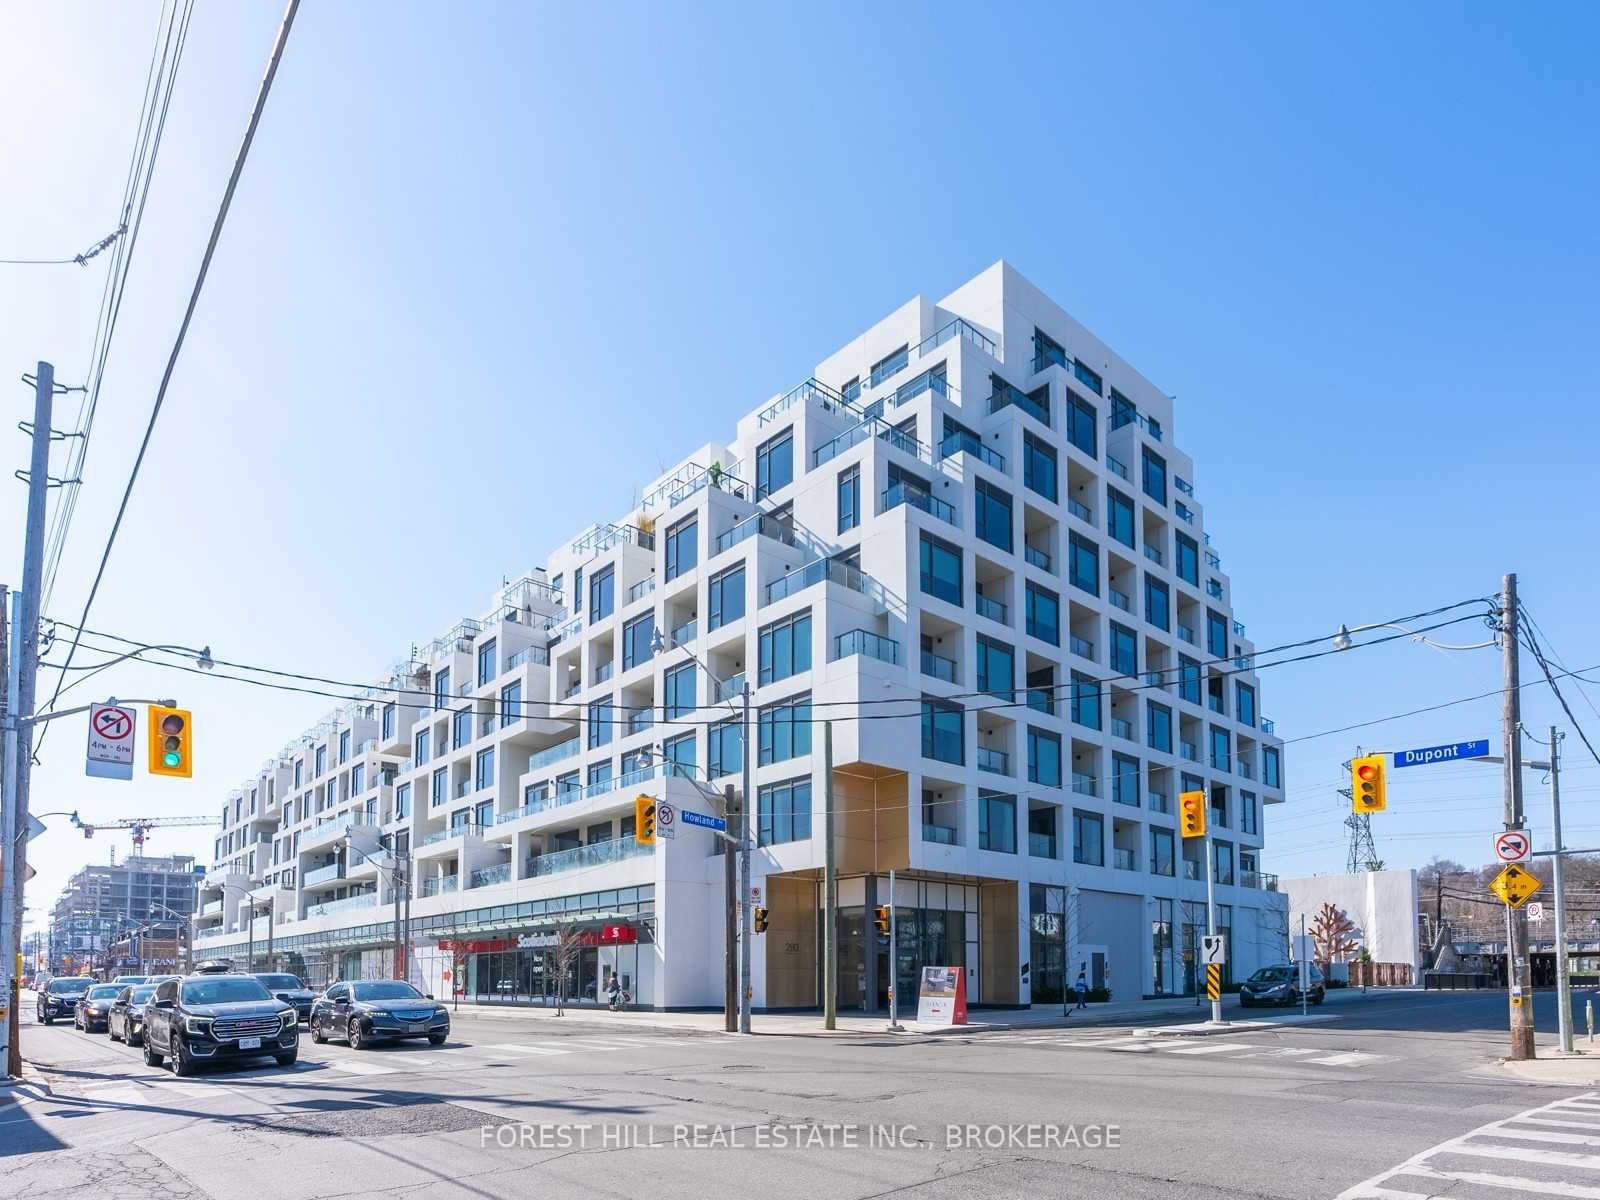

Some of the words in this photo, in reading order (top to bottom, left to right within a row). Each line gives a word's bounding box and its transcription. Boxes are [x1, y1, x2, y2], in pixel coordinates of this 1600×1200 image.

[92, 741, 107, 749] 4PM
[1406, 745, 1458, 762] Dupont
[684, 811, 715, 826] Howland
